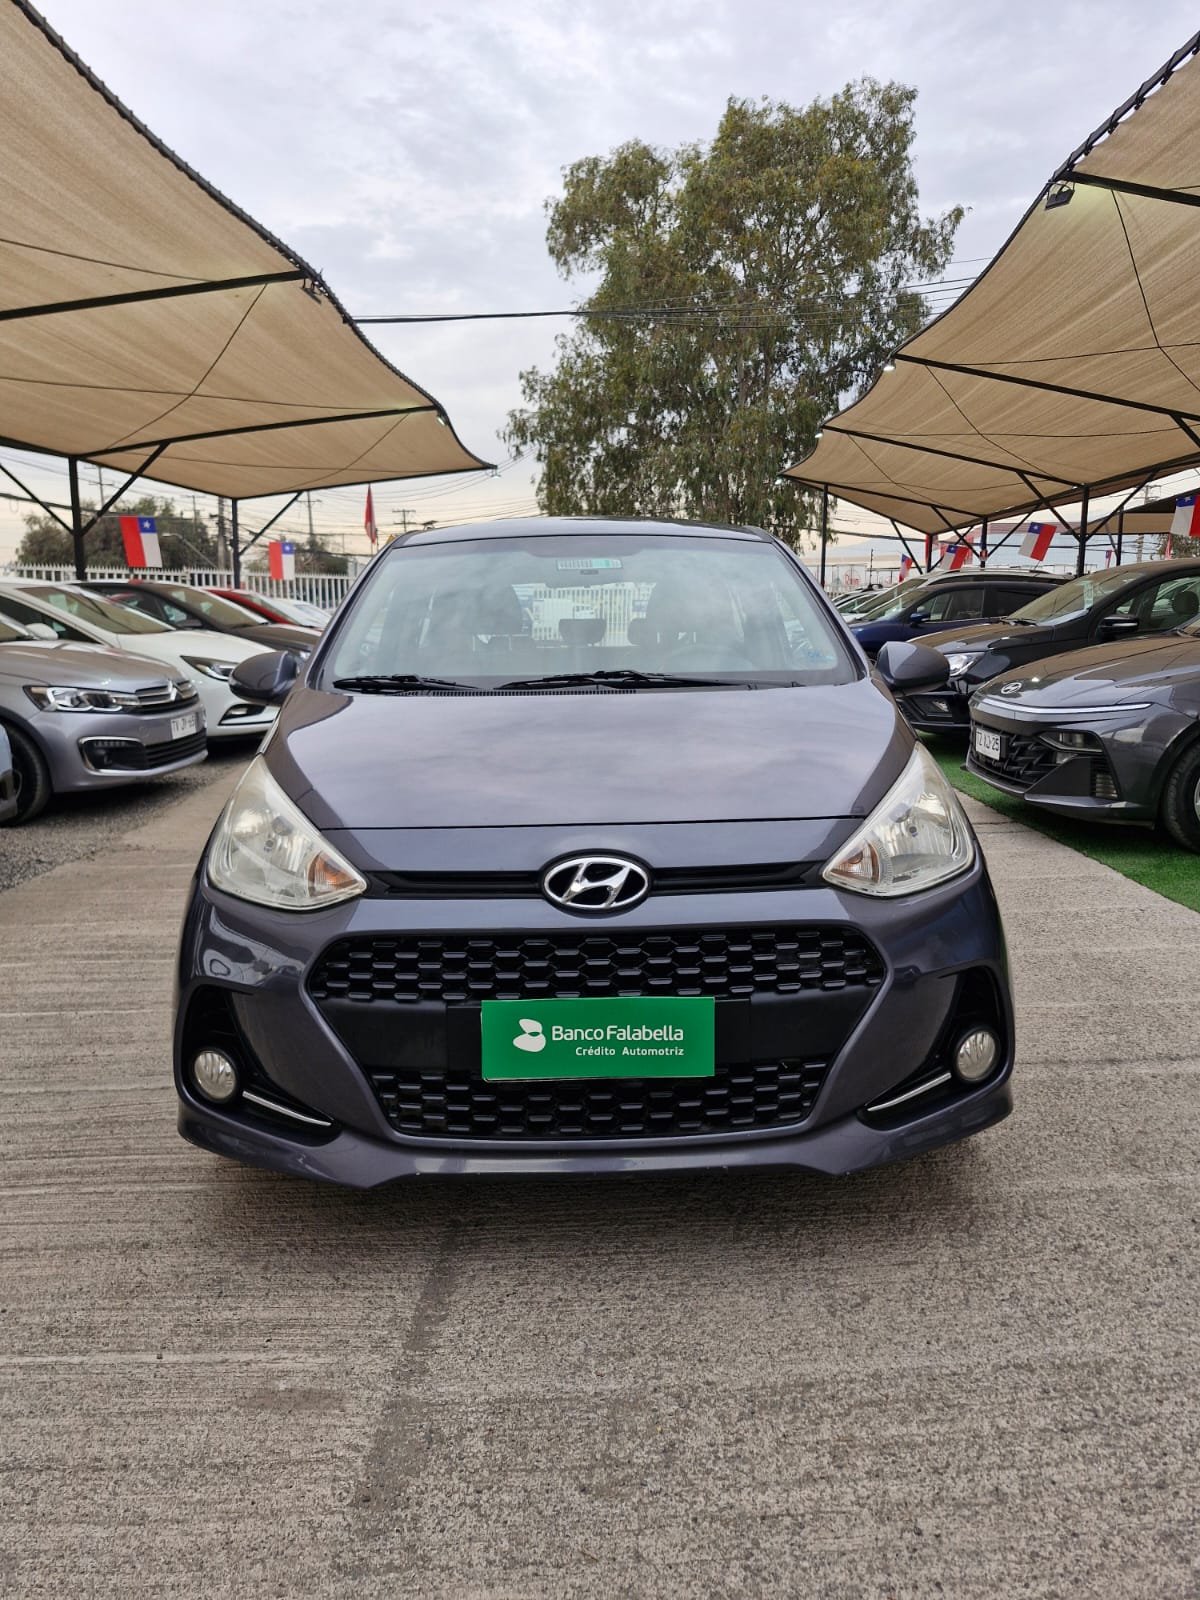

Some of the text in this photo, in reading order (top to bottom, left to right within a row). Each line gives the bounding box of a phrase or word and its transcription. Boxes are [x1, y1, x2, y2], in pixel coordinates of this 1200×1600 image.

[551, 1025, 684, 1041] Banco Falabella
[575, 1046, 684, 1056] Crédito Automotriz
